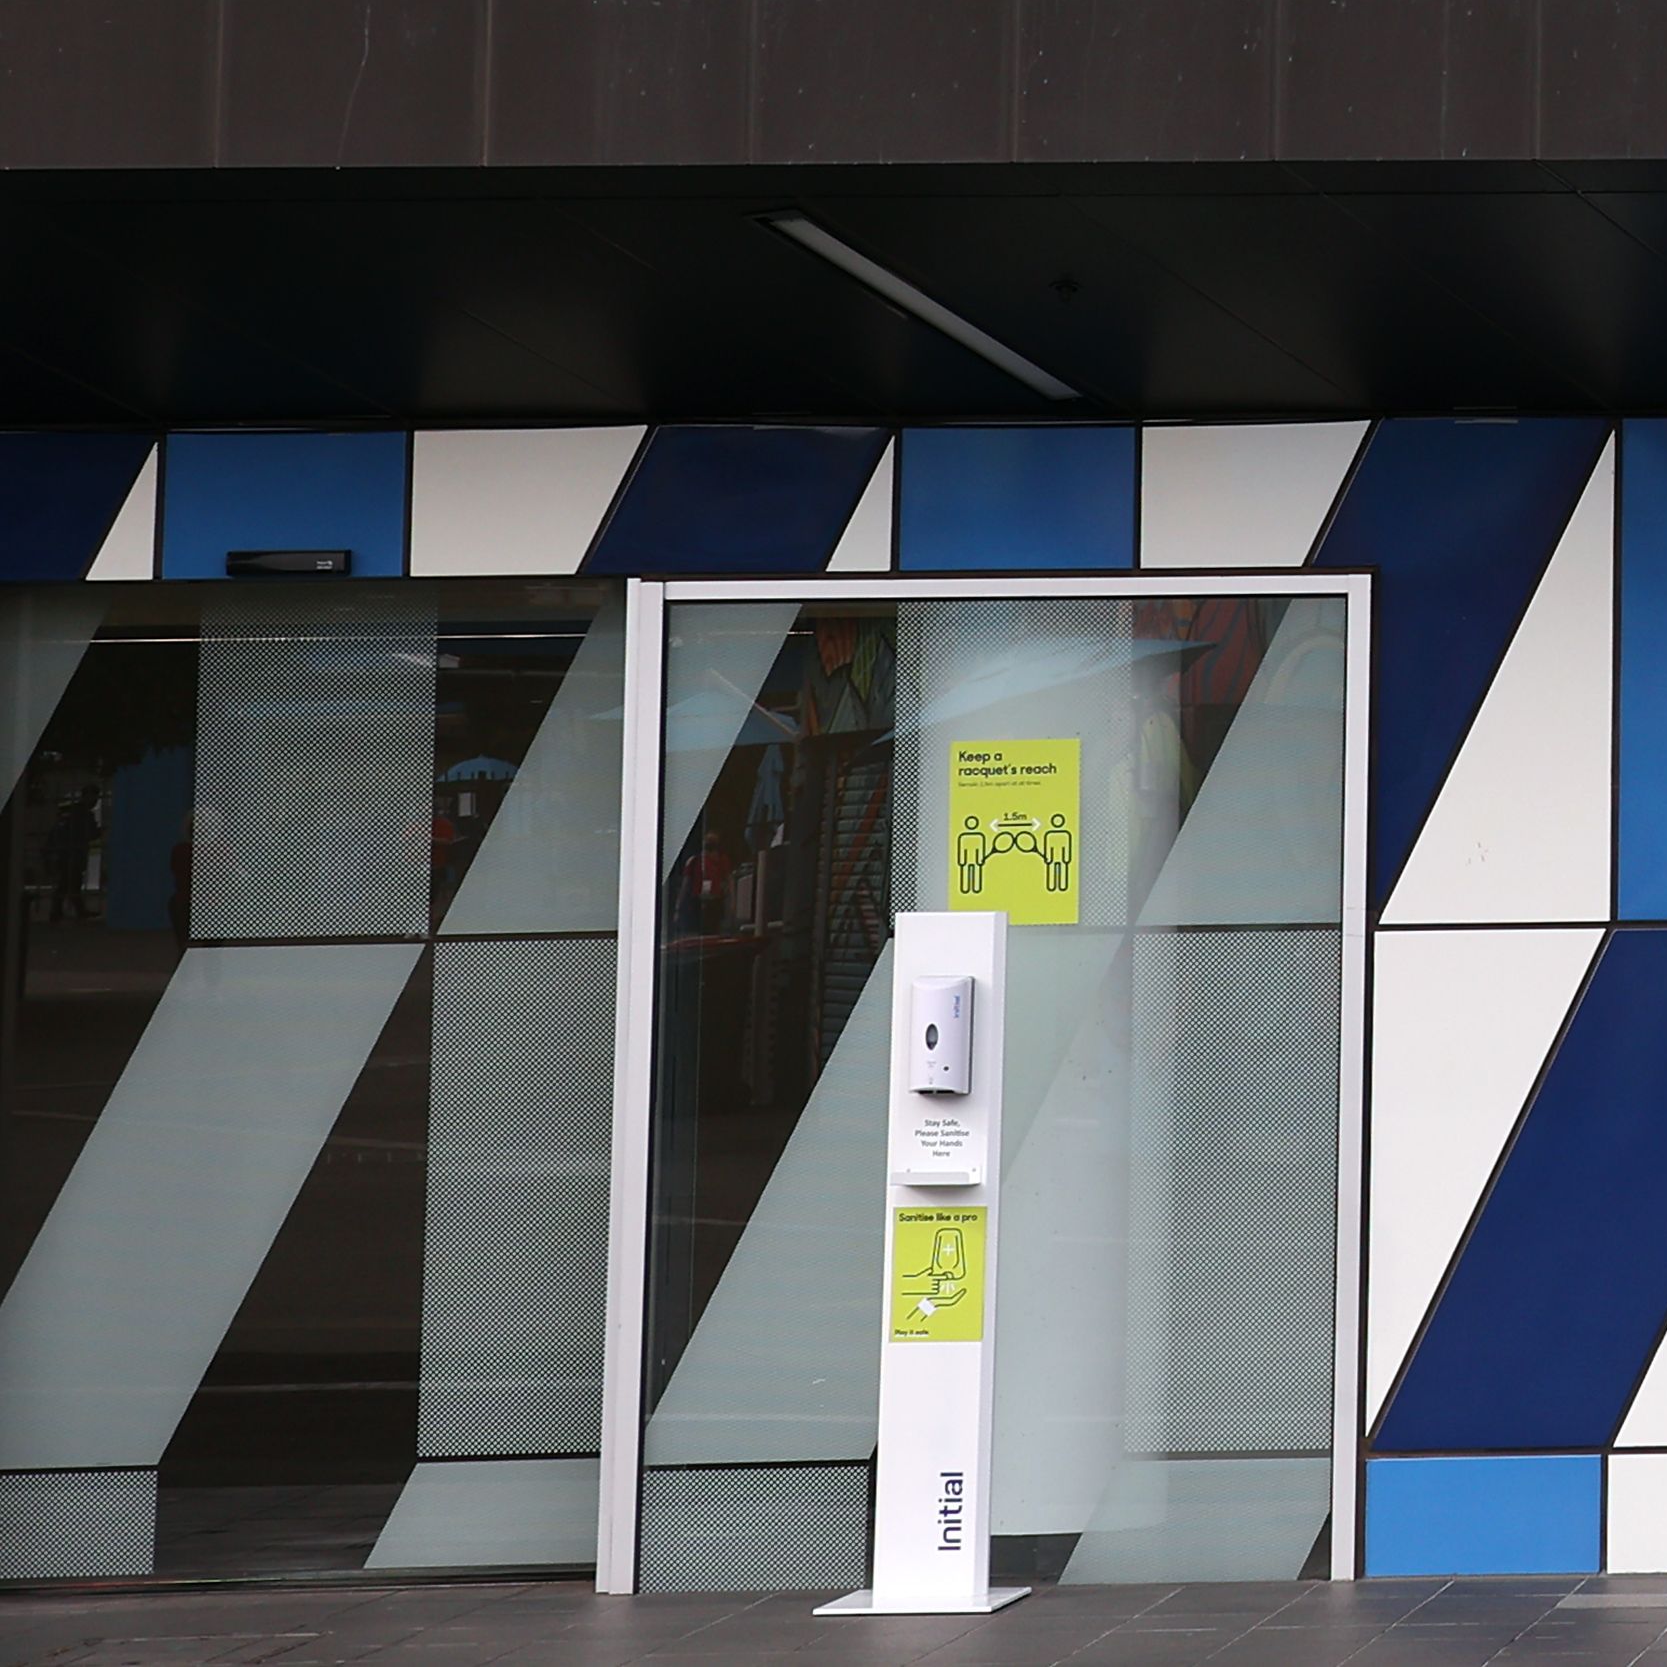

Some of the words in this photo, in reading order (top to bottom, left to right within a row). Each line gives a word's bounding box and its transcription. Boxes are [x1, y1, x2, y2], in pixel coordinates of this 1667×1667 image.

[958, 750, 991, 764] Keep
[994, 752, 1003, 762] a
[958, 764, 1017, 778] racquet's
[1020, 763, 1057, 775] reach
[1003, 812, 1027, 821] 1.5m
[924, 1119, 941, 1127] Stay
[942, 1119, 961, 1127] Safe,
[914, 1129, 939, 1137] Please
[940, 1129, 970, 1137] Sanitise
[899, 1212, 934, 1222] Sanitise
[936, 1212, 951, 1221] like
[961, 1214, 978, 1223] pro
[938, 1472, 963, 1551] Initial
